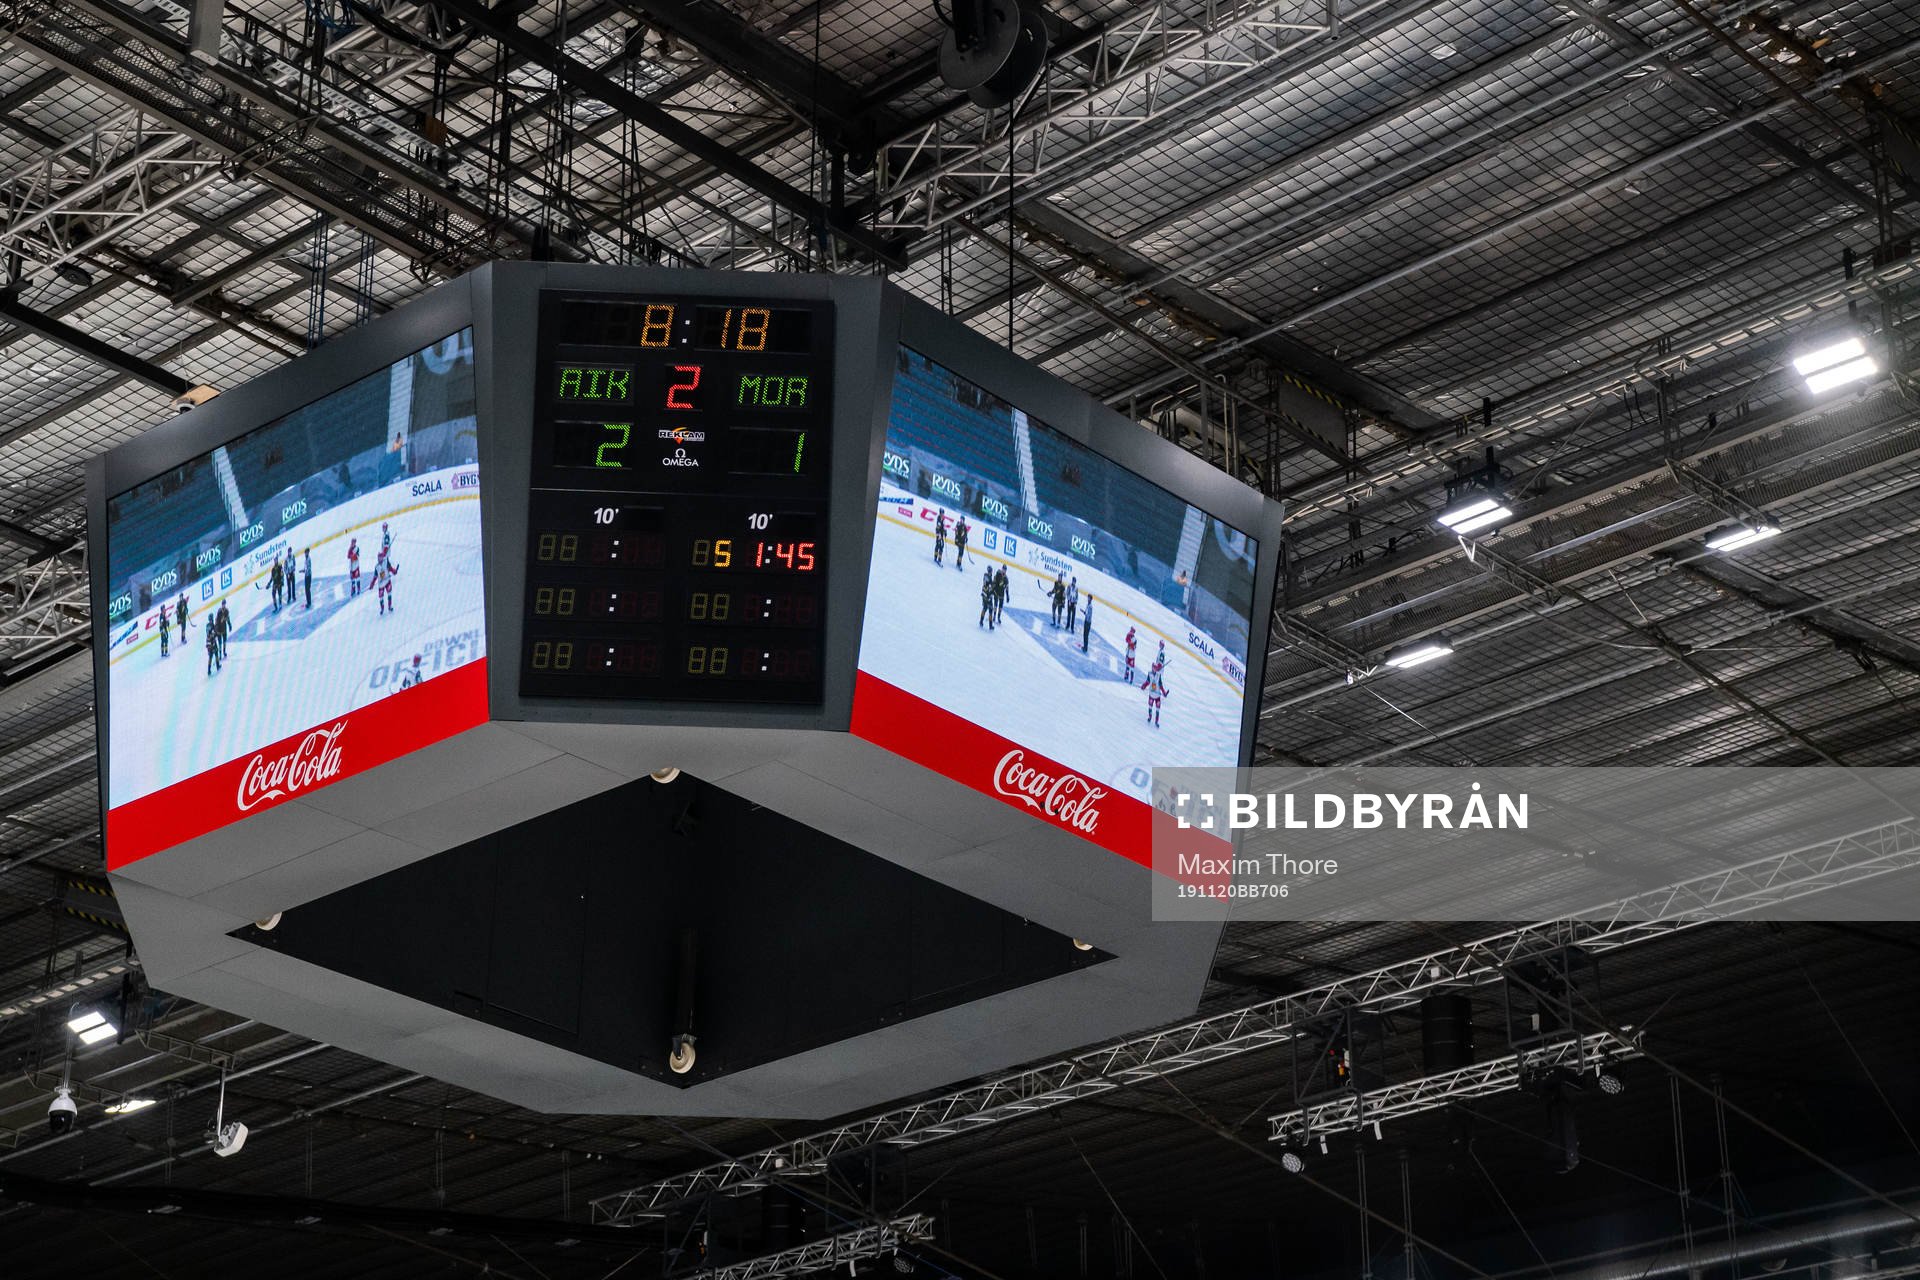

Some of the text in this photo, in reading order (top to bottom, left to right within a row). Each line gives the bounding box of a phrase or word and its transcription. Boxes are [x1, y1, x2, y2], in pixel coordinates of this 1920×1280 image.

[640, 304, 771, 352] 8:18
[559, 368, 631, 399] AIK
[666, 365, 702, 410] 2
[738, 375, 808, 406] MOR
[596, 423, 631, 468] 2
[658, 430, 705, 440] REKLAM
[662, 457, 699, 467] OMEGA
[412, 480, 442, 497] SCALA
[932, 473, 961, 497] RYDS
[282, 498, 307, 522] RYDS
[982, 495, 1009, 518] RYDS
[240, 521, 264, 545] RYDS
[1028, 516, 1053, 538] RYDS
[196, 544, 221, 569] RYDS
[755, 541, 815, 571] 1:45
[1071, 535, 1096, 556] RYDS
[151, 568, 177, 593] RYDS
[110, 592, 132, 616] YDS
[1188, 632, 1215, 660] SCALA
[237, 719, 349, 811] Coca-Cola
[993, 749, 1108, 836] Coca-Cola
